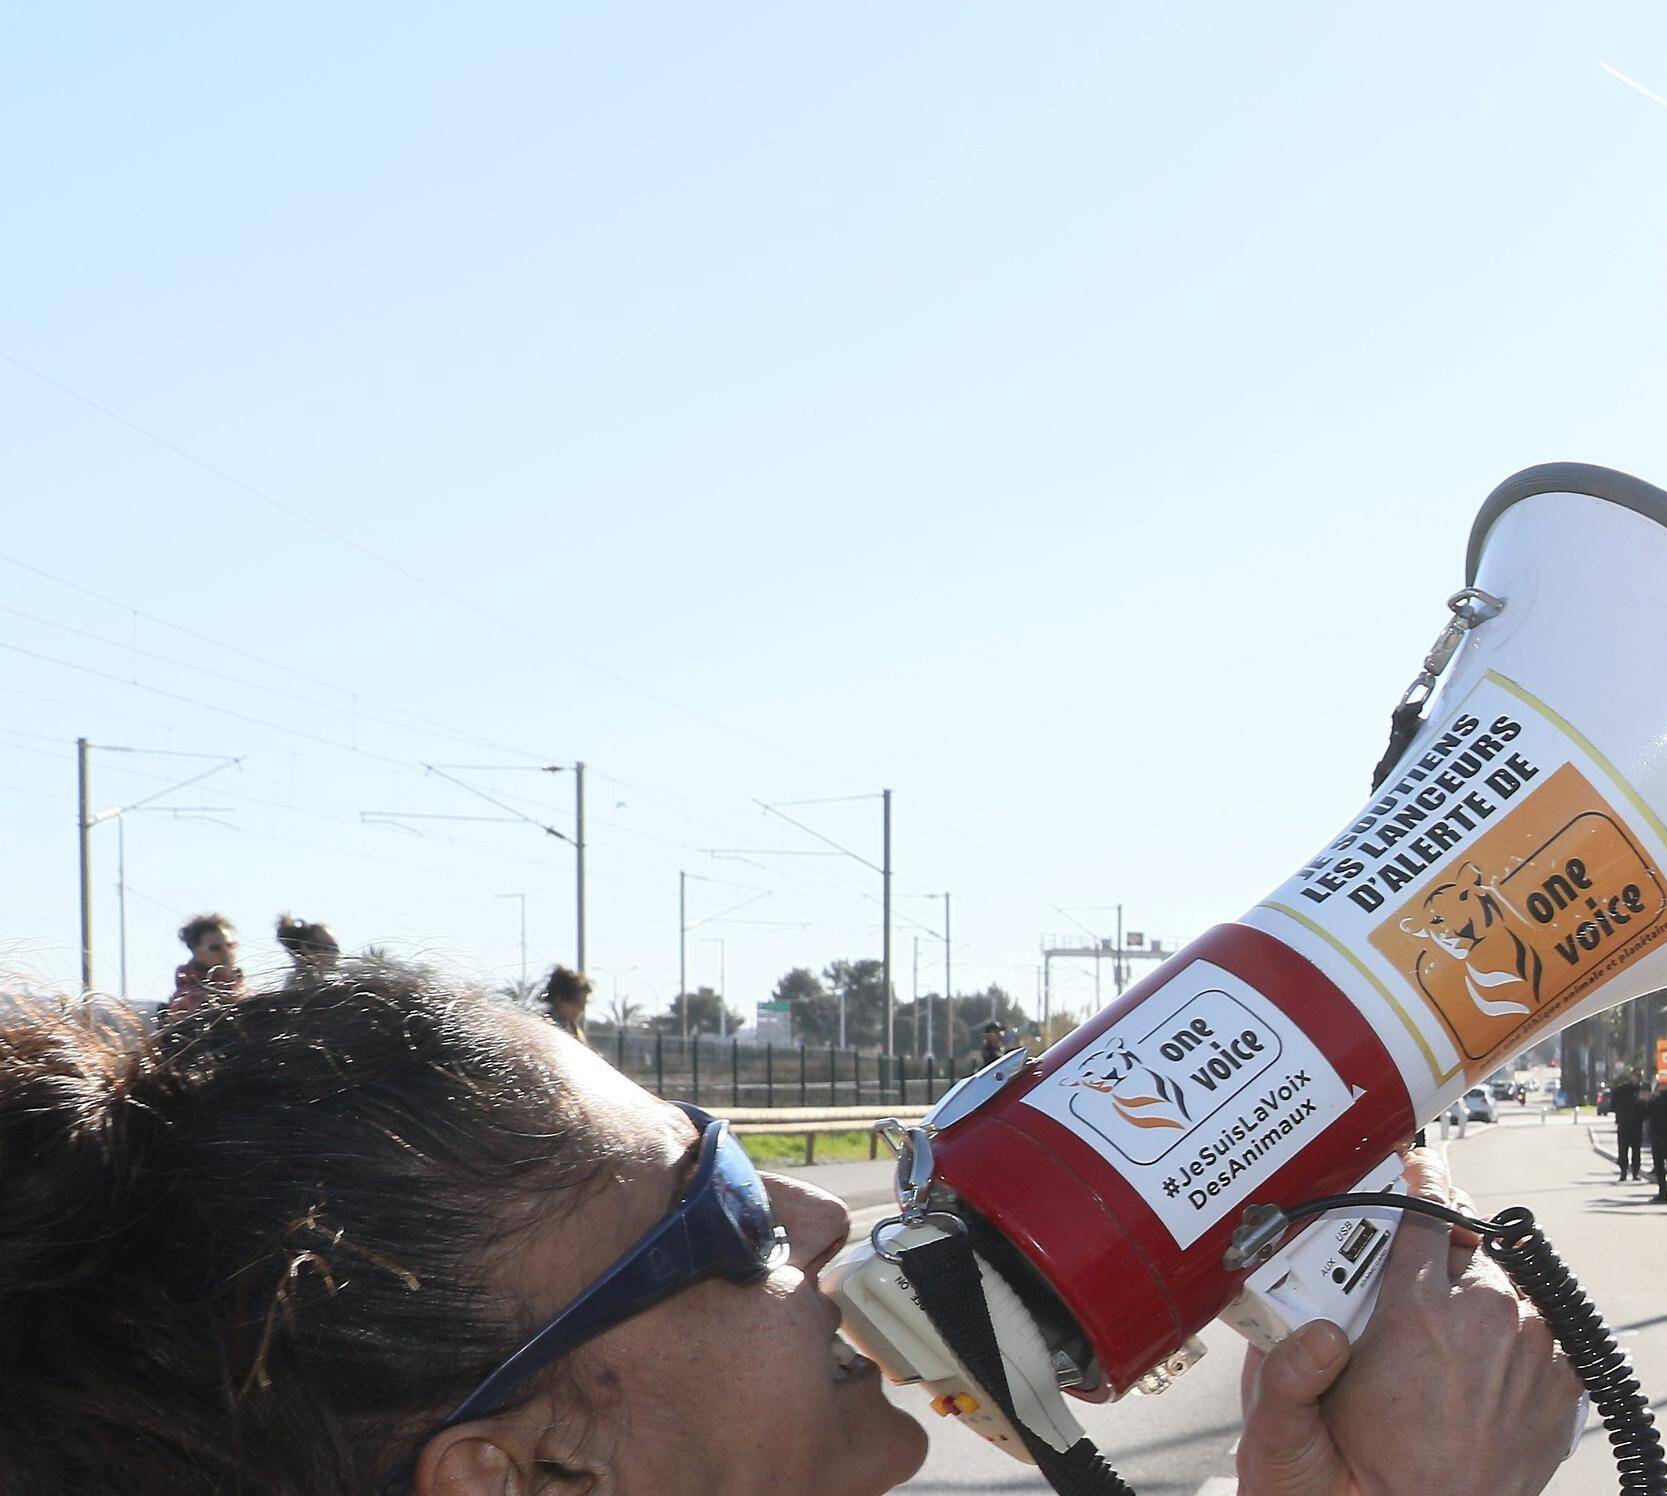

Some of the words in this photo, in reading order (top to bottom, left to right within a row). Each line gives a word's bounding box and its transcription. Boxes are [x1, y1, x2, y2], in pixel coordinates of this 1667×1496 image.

[1300, 857, 1361, 904] LES
[1357, 714, 1523, 860] LANCEURS
[1331, 713, 1480, 852] SOUTIENS
[1347, 791, 1496, 914] D'ALERTE
[1485, 751, 1541, 800] DE
[1525, 857, 1593, 924] one
[1554, 881, 1647, 966] voice
[1563, 970, 1605, 1008] animale
[1605, 957, 1619, 971] et
[1159, 1017, 1215, 1062] one
[1189, 1029, 1265, 1092] voice
[1161, 1069, 1313, 1198] #JeSuisLaVoix
[1187, 1098, 1318, 1211] DesAnimaux
[1320, 1257, 1337, 1277] AUX
[1335, 1221, 1353, 1242] USB
